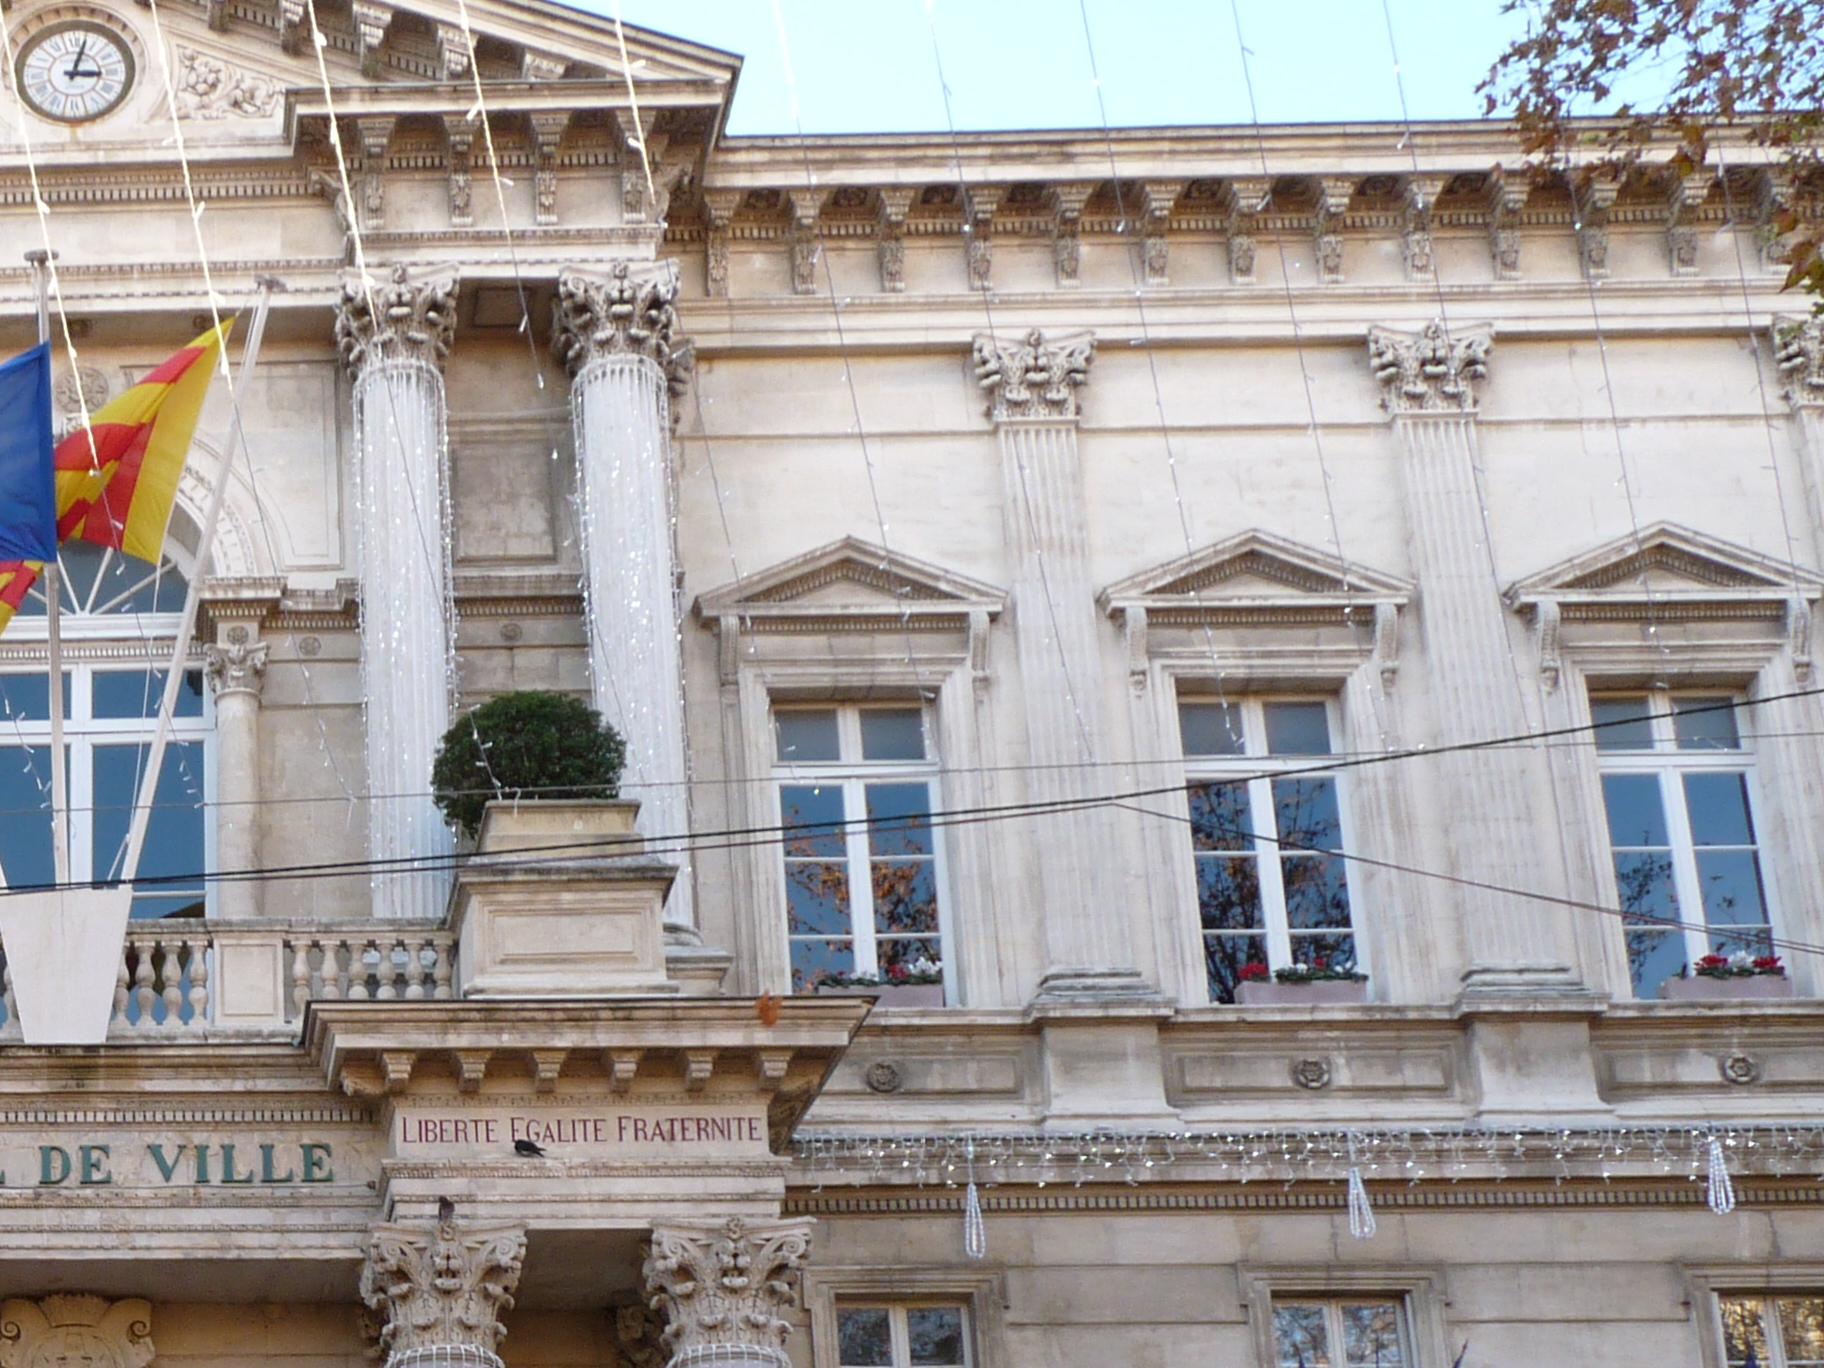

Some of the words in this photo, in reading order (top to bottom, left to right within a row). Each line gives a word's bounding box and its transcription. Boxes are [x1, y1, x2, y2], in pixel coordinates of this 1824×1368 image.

[402, 1117, 499, 1143] LIBERTE
[510, 1117, 608, 1143] EGALITE
[618, 1116, 763, 1142] FRATERNITE
[39, 1144, 113, 1185] DE
[146, 1143, 334, 1184] VILLE
